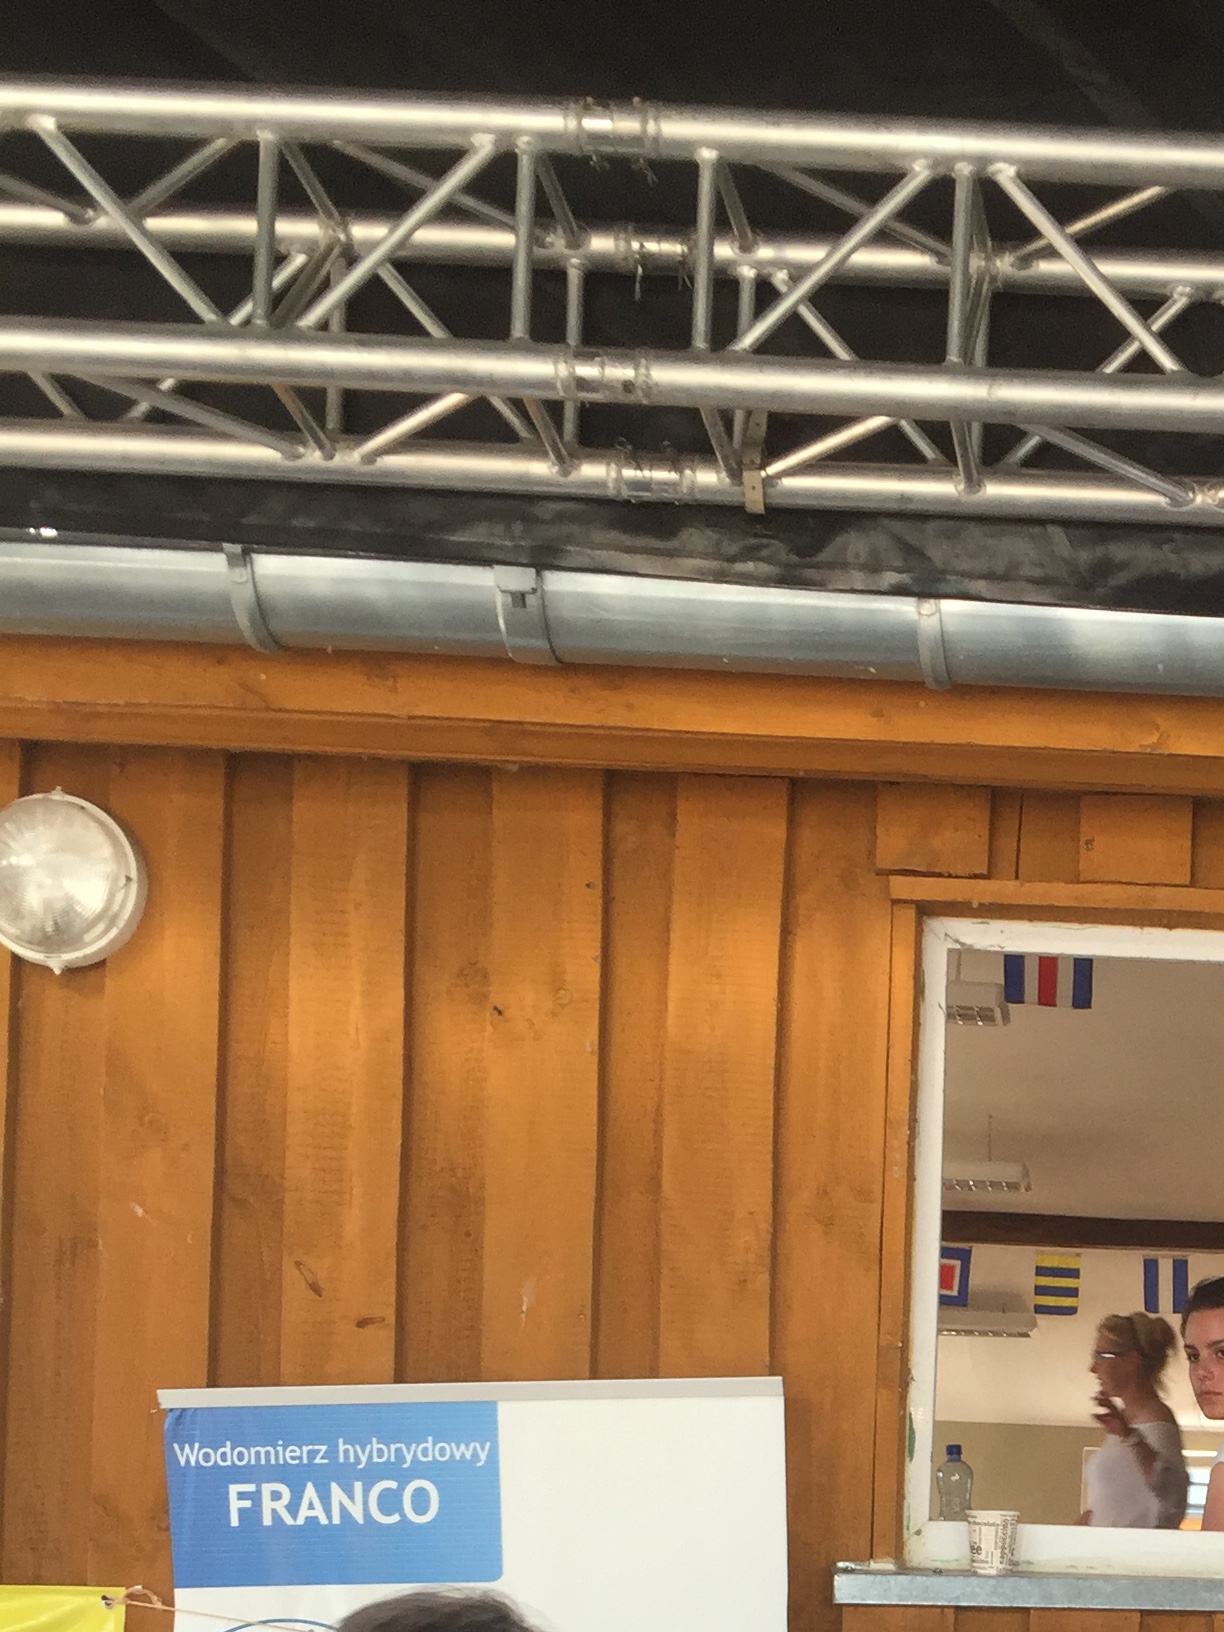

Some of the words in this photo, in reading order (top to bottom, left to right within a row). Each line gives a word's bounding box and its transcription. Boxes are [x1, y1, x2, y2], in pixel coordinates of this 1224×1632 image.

[173, 1440, 328, 1467] Wodomierz
[338, 1436, 491, 1469] hybrydowy
[228, 1479, 440, 1527] FRANCO
